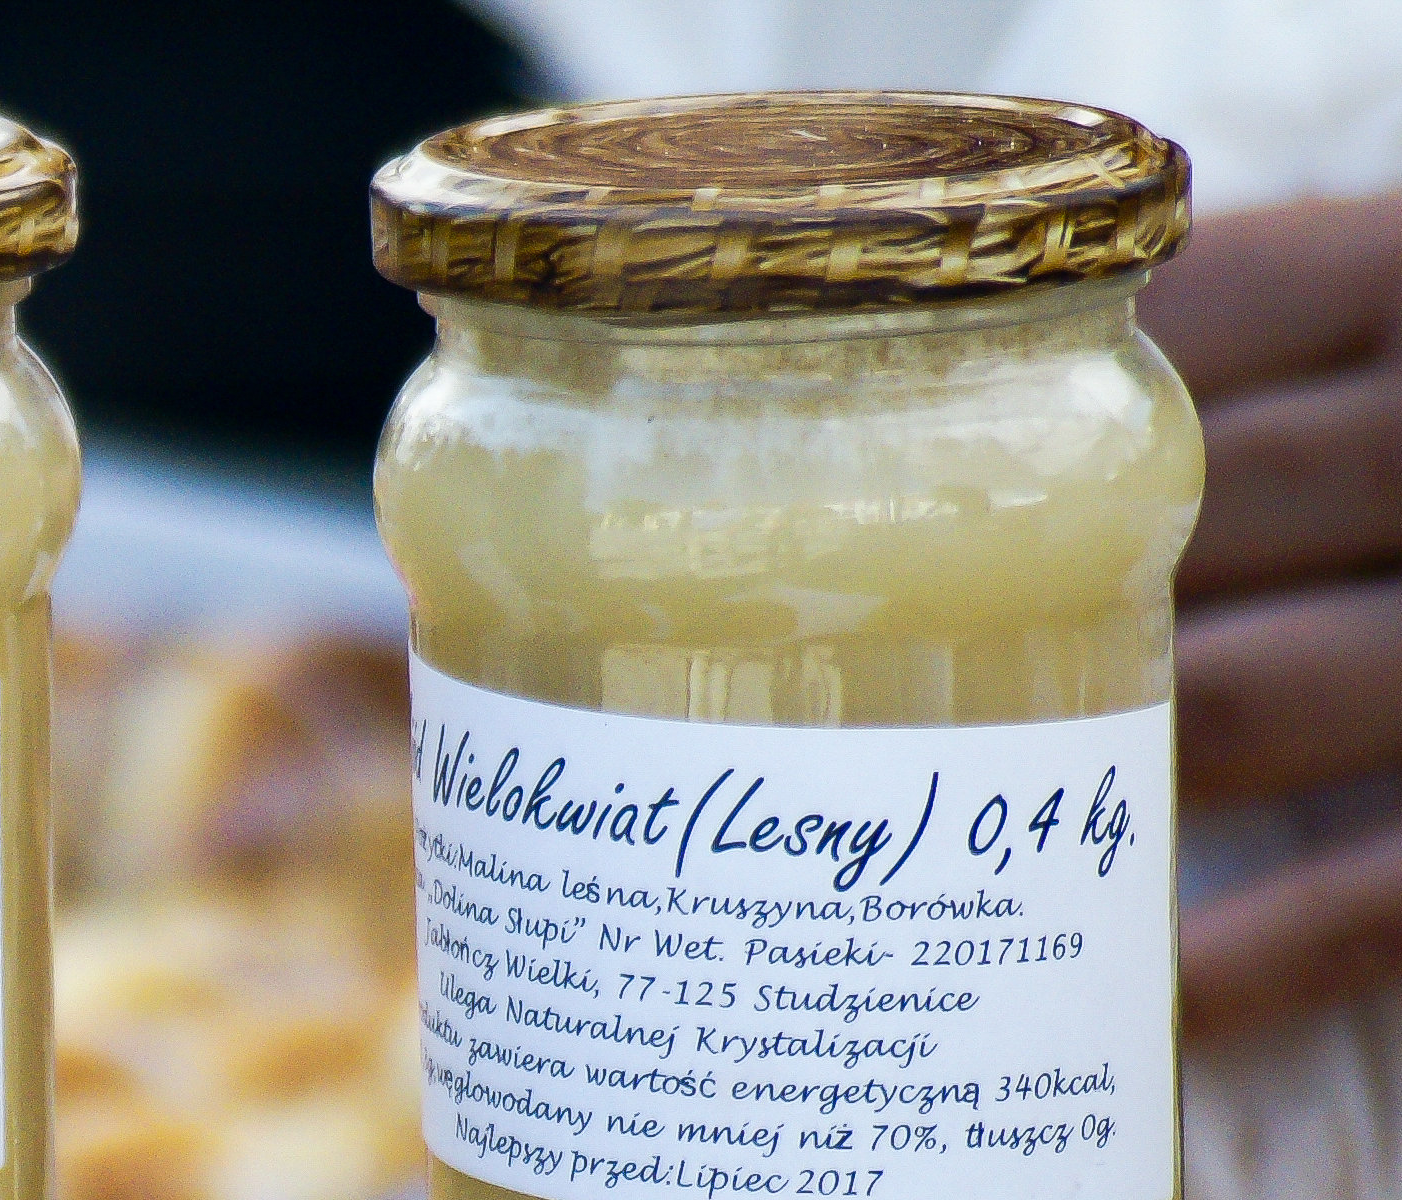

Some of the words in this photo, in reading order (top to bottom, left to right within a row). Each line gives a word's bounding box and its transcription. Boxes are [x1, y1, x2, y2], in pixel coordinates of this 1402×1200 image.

[1079, 765, 1135, 878] kg.
[599, 923, 641, 953] Nr
[654, 928, 724, 962] Wet.
[910, 932, 1084, 966] 220171169
[439, 970, 498, 1020] Ulega
[505, 995, 680, 1059] Naturalnej
[696, 1025, 939, 1070] Krystalizacji
[505, 949, 599, 999] Wielki,
[619, 973, 737, 1009] 77-125
[753, 983, 981, 1023] Studzienice
[467, 1037, 575, 1079] zawiera
[584, 1064, 717, 1099] wartość
[731, 1078, 980, 1115] energetyczną
[994, 1062, 1116, 1103] 340kcal,
[455, 1112, 563, 1176] Najlepszy
[795, 1168, 885, 1197] 2017
[607, 1112, 665, 1138] nie
[677, 1121, 785, 1158] mniej
[799, 1123, 854, 1151] niż
[871, 1123, 948, 1155] 70%,
[965, 1121, 1074, 1157] tłuszcz
[1081, 1113, 1116, 1149] 0g.
